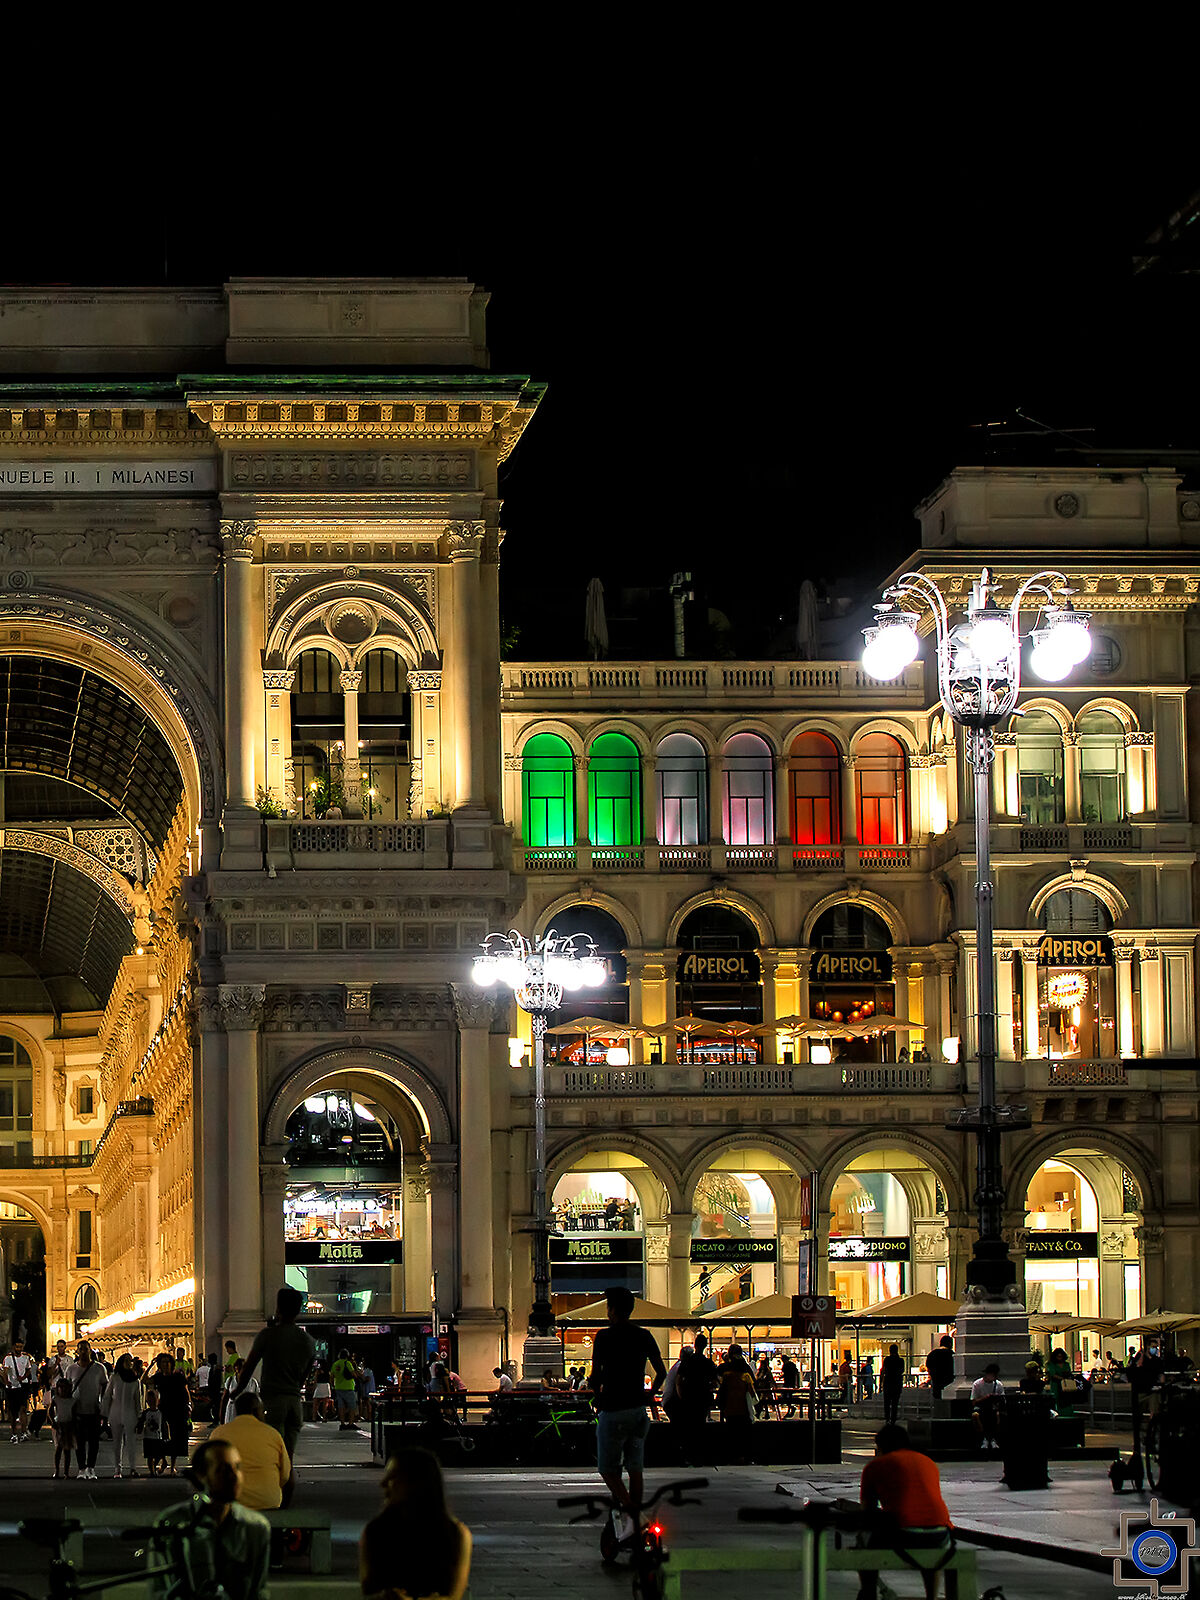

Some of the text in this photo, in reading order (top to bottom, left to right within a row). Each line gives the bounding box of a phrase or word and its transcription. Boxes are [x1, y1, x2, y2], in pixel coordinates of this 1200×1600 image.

[65, 471, 81, 484] II.
[95, 471, 101, 484] I
[111, 470, 195, 484] MILANESI
[1039, 937, 1107, 958] APEROL
[683, 954, 750, 974] APEROL
[816, 953, 882, 974] APEROL
[1039, 957, 1107, 965] TERRAZZA
[319, 1243, 363, 1259] Motta
[567, 1240, 612, 1256] Motta
[691, 1243, 726, 1252] ERCATO
[738, 1243, 774, 1252] DUOMO
[871, 1241, 907, 1250] DUOMO
[1055, 1240, 1064, 1252] &
[807, 1320, 822, 1333] M
